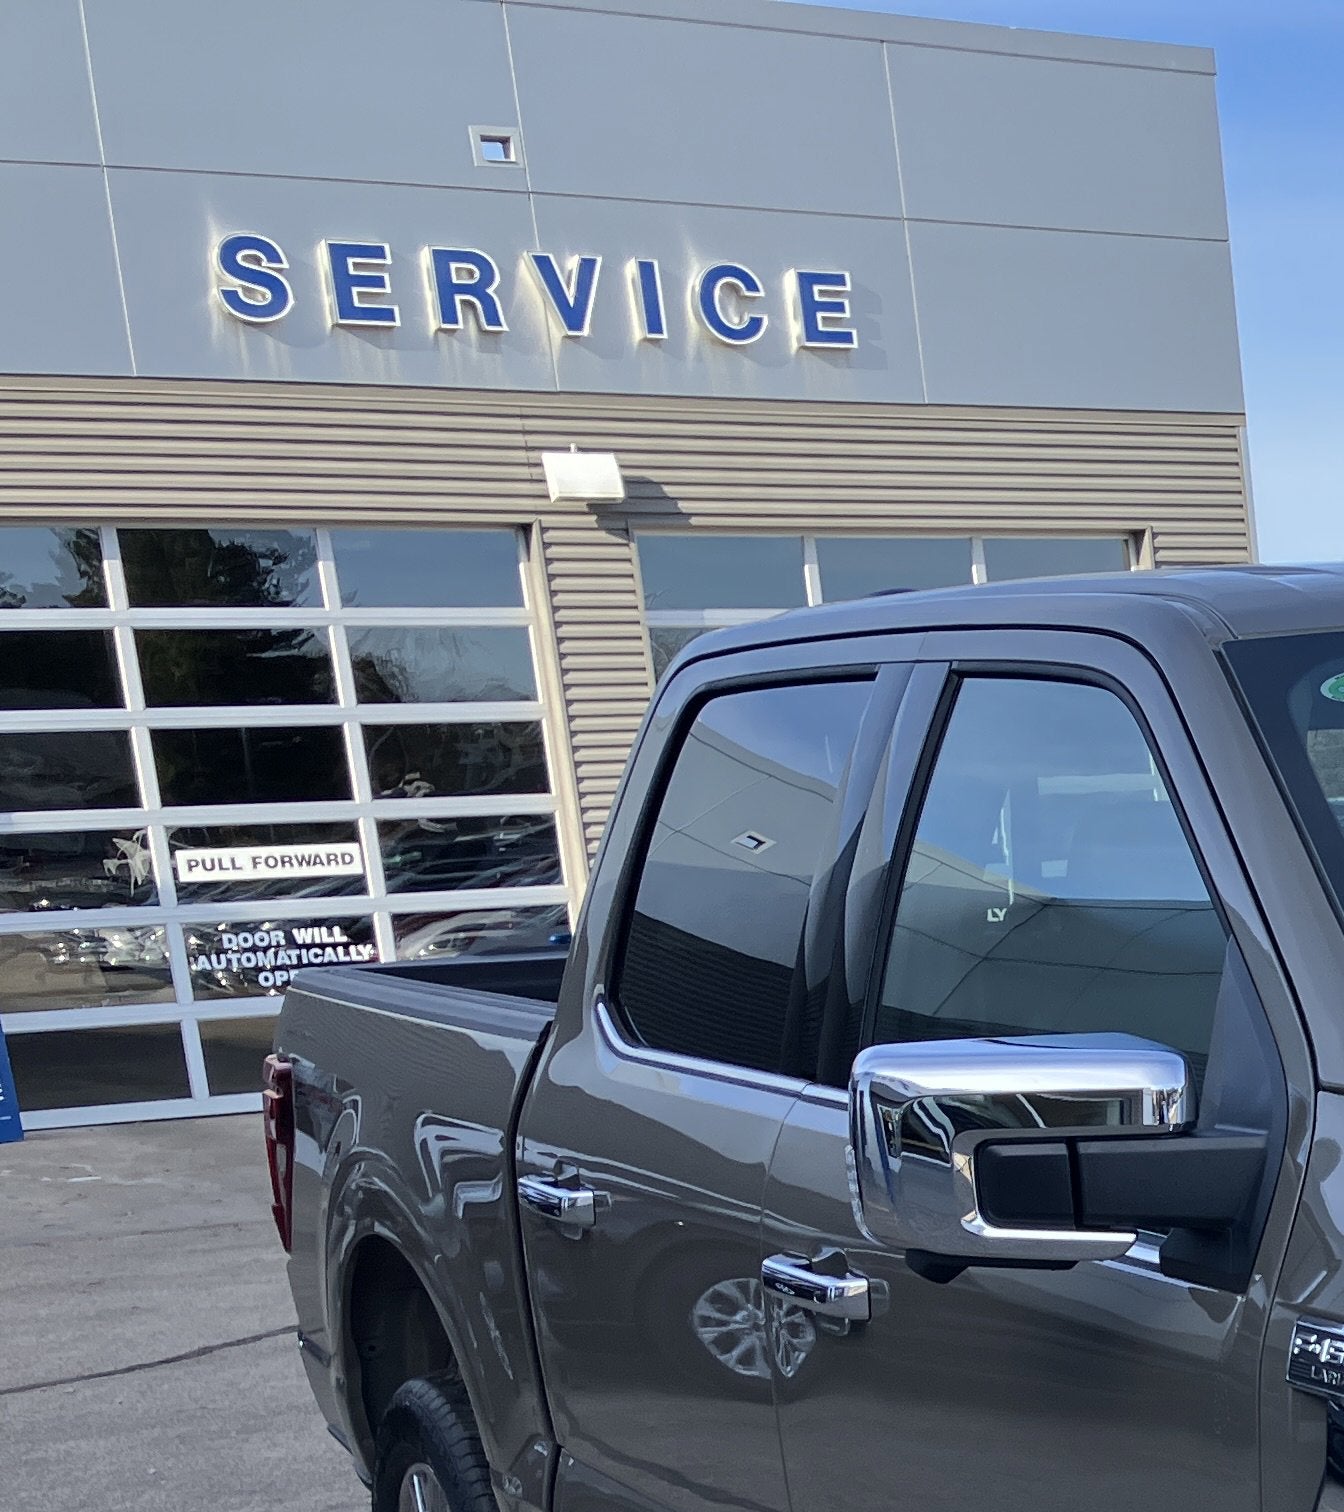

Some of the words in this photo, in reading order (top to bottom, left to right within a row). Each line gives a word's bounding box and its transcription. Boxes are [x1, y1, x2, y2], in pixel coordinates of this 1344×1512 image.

[215, 231, 860, 351] SERVICE
[186, 854, 244, 873] PULL
[251, 850, 356, 871] FORWARD
[221, 930, 286, 949] DOOR
[292, 925, 348, 944] WILL
[197, 944, 374, 971] AUTOMATICALLY
